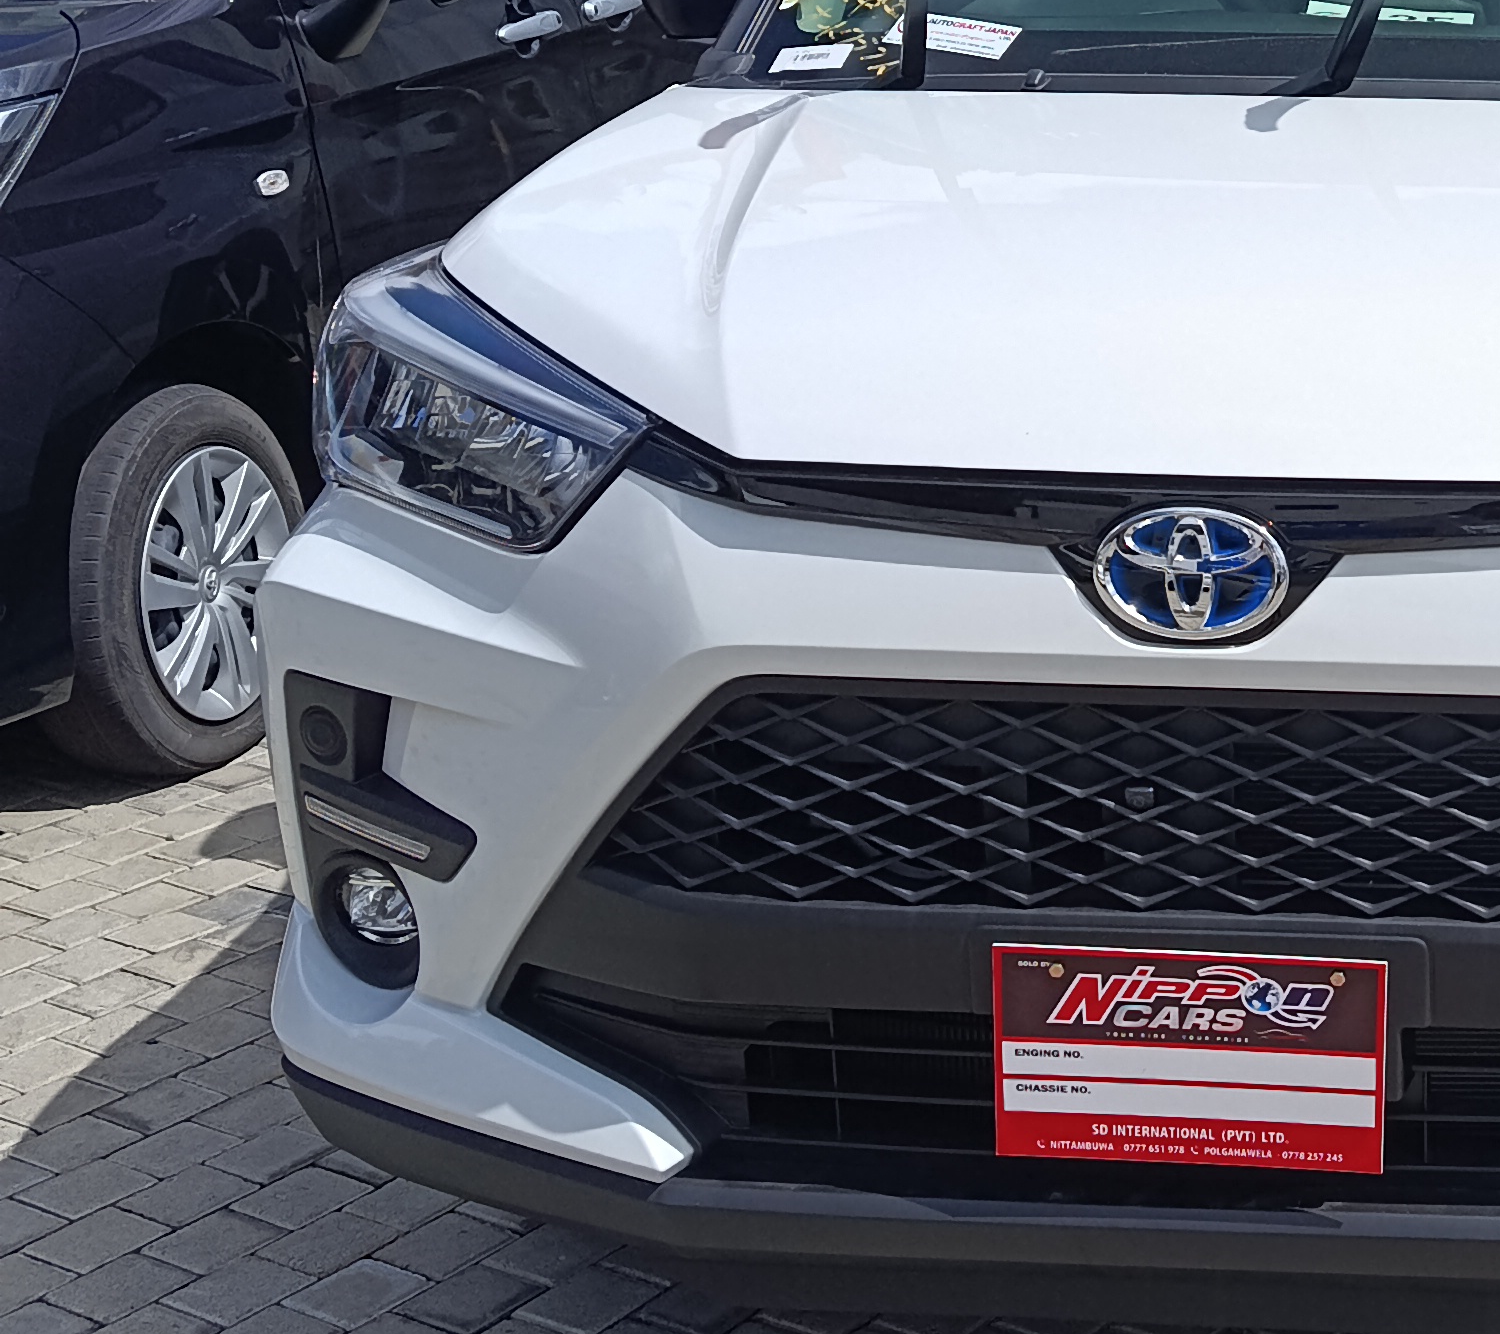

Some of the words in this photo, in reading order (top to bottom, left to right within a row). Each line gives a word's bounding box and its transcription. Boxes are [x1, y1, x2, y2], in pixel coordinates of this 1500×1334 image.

[926, 18, 986, 31] AUTOCRAFT
[983, 25, 1019, 37] JAPAN
[1113, 1004, 1246, 1032] CARS
[1063, 1050, 1084, 1059] NO.
[1016, 1083, 1068, 1094] CHASSIE
[1071, 1085, 1091, 1095] NO.
[1092, 1123, 1108, 1136] SD
[1112, 1125, 1215, 1141] INTERNATIONAL
[1221, 1129, 1256, 1144] (PVT)
[1261, 1131, 1290, 1144] LTD.
[1050, 1140, 1114, 1151] NITTAMBUWA
[1123, 1143, 1146, 1153] 0777
[1148, 1144, 1165, 1154] 651
[1167, 1145, 1185, 1154] 978
[1204, 1146, 1273, 1159] POLGAHAWELA
[1281, 1150, 1305, 1161] 0778
[1306, 1151, 1324, 1161] 257
